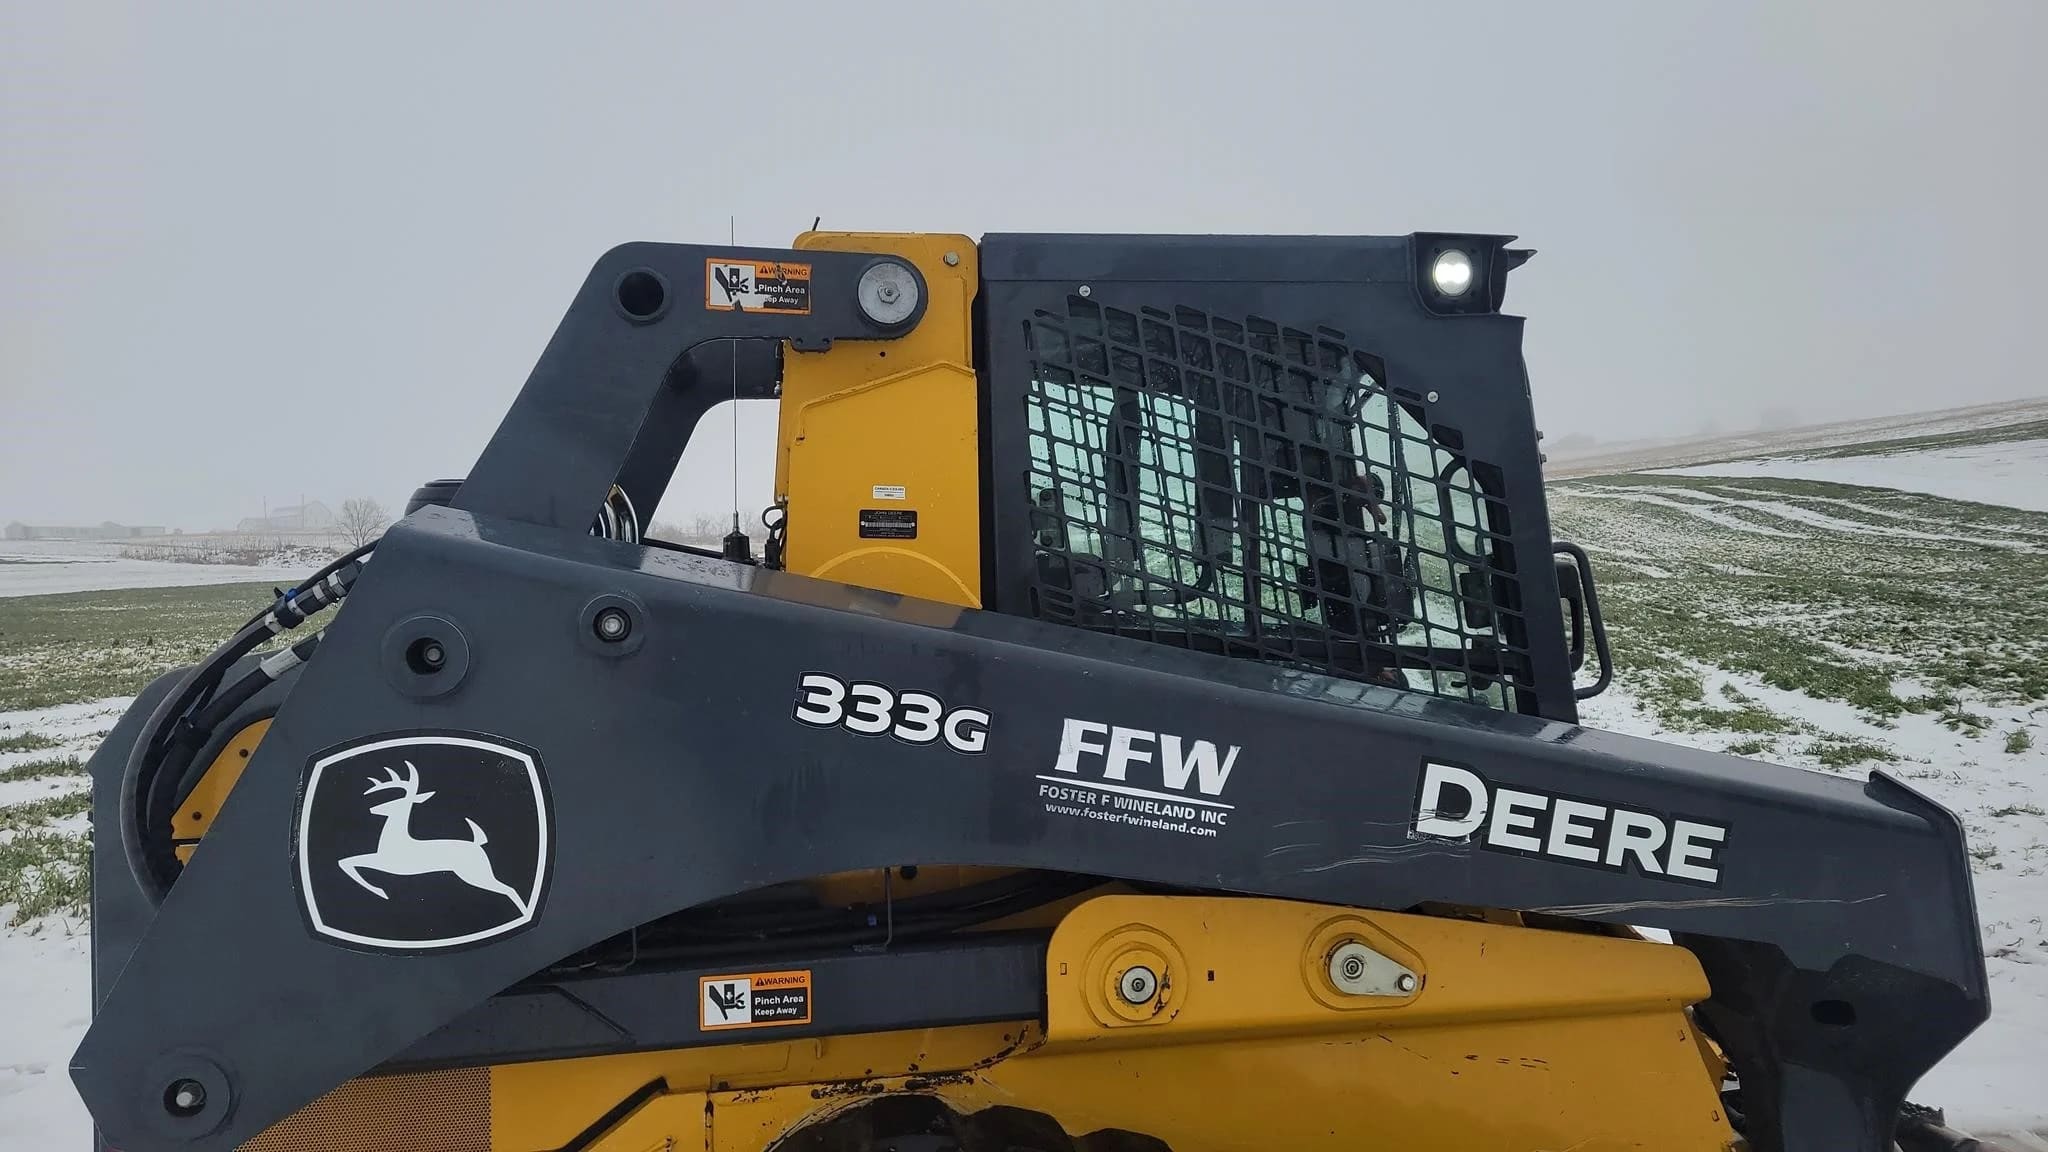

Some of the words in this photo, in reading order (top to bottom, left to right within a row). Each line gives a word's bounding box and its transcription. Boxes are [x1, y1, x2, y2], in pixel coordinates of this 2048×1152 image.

[758, 284, 783, 293] Pinch
[785, 285, 805, 294] Area
[778, 296, 799, 304] Away
[796, 675, 990, 752] 333G
[1054, 718, 1241, 797] FFW
[1039, 784, 1097, 806] FOSTER
[1101, 795, 1111, 807] F
[1113, 796, 1196, 820] WINELAND
[1200, 810, 1228, 826] INC
[1045, 802, 1218, 838] www.fosterfwineland.com
[1416, 763, 1727, 884] DEERE
[764, 976, 805, 985] WARNING
[754, 996, 781, 1005] Pinch
[782, 995, 804, 1004] Area
[754, 1008, 775, 1016] Keep
[776, 1007, 797, 1015] Away
